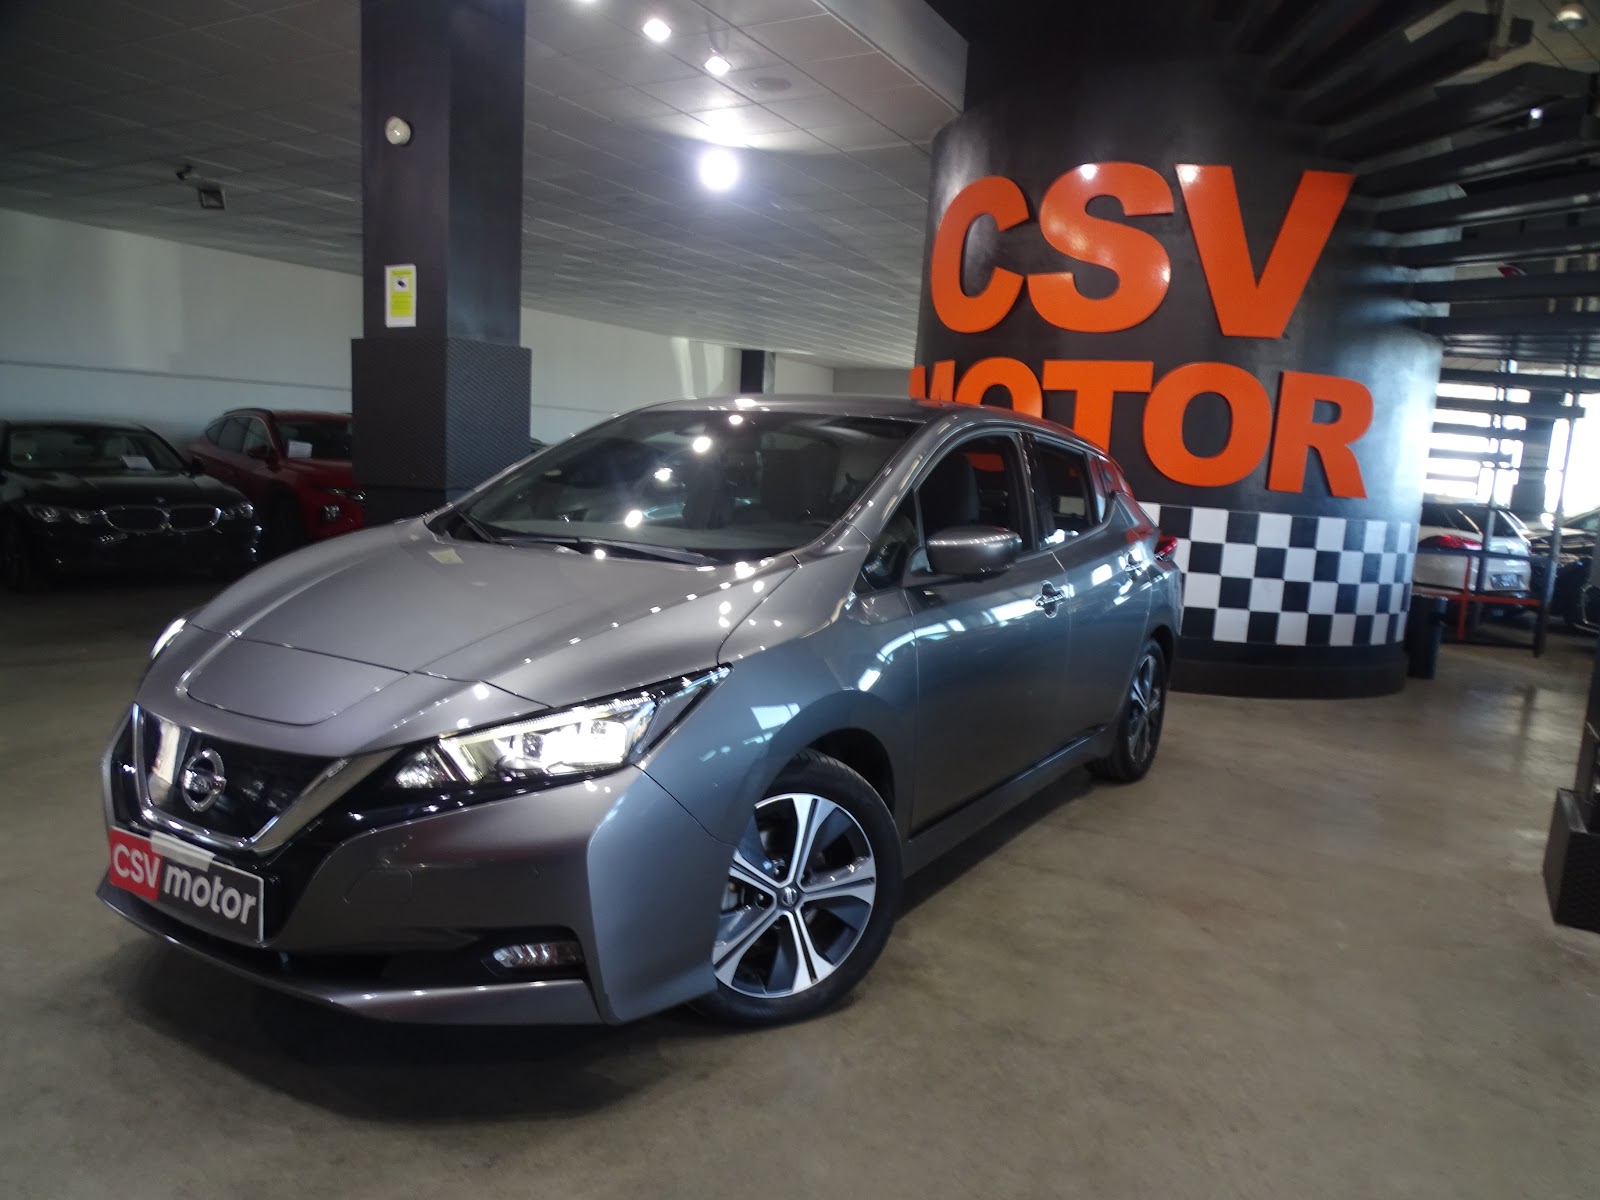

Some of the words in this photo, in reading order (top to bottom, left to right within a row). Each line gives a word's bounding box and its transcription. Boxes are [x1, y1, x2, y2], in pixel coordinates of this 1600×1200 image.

[931, 161, 1356, 339] CSV
[113, 842, 160, 888] CSV
[163, 863, 257, 925] motor
